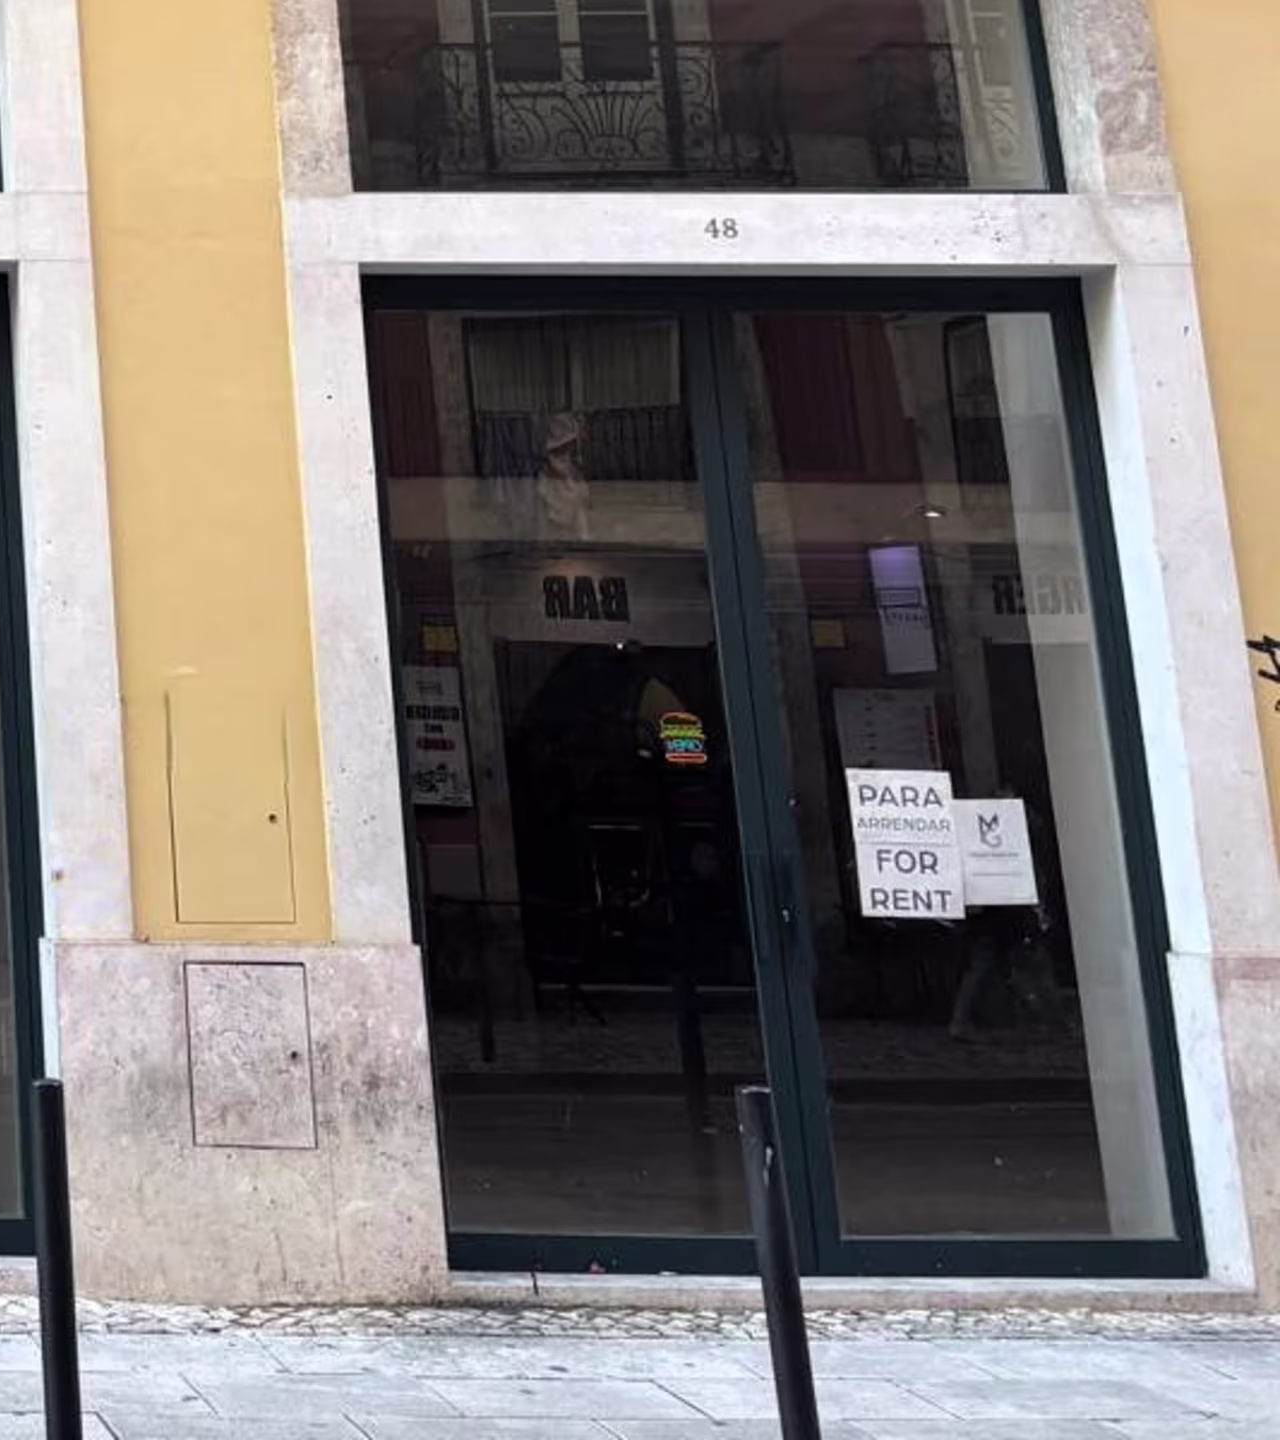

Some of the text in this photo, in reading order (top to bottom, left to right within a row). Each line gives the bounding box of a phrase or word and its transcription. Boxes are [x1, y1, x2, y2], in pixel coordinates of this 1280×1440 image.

[703, 217, 739, 239] 48
[858, 784, 944, 808] PARA
[857, 816, 952, 833] ARRENDAR
[876, 849, 939, 875] FOR
[870, 888, 952, 912] RENT
